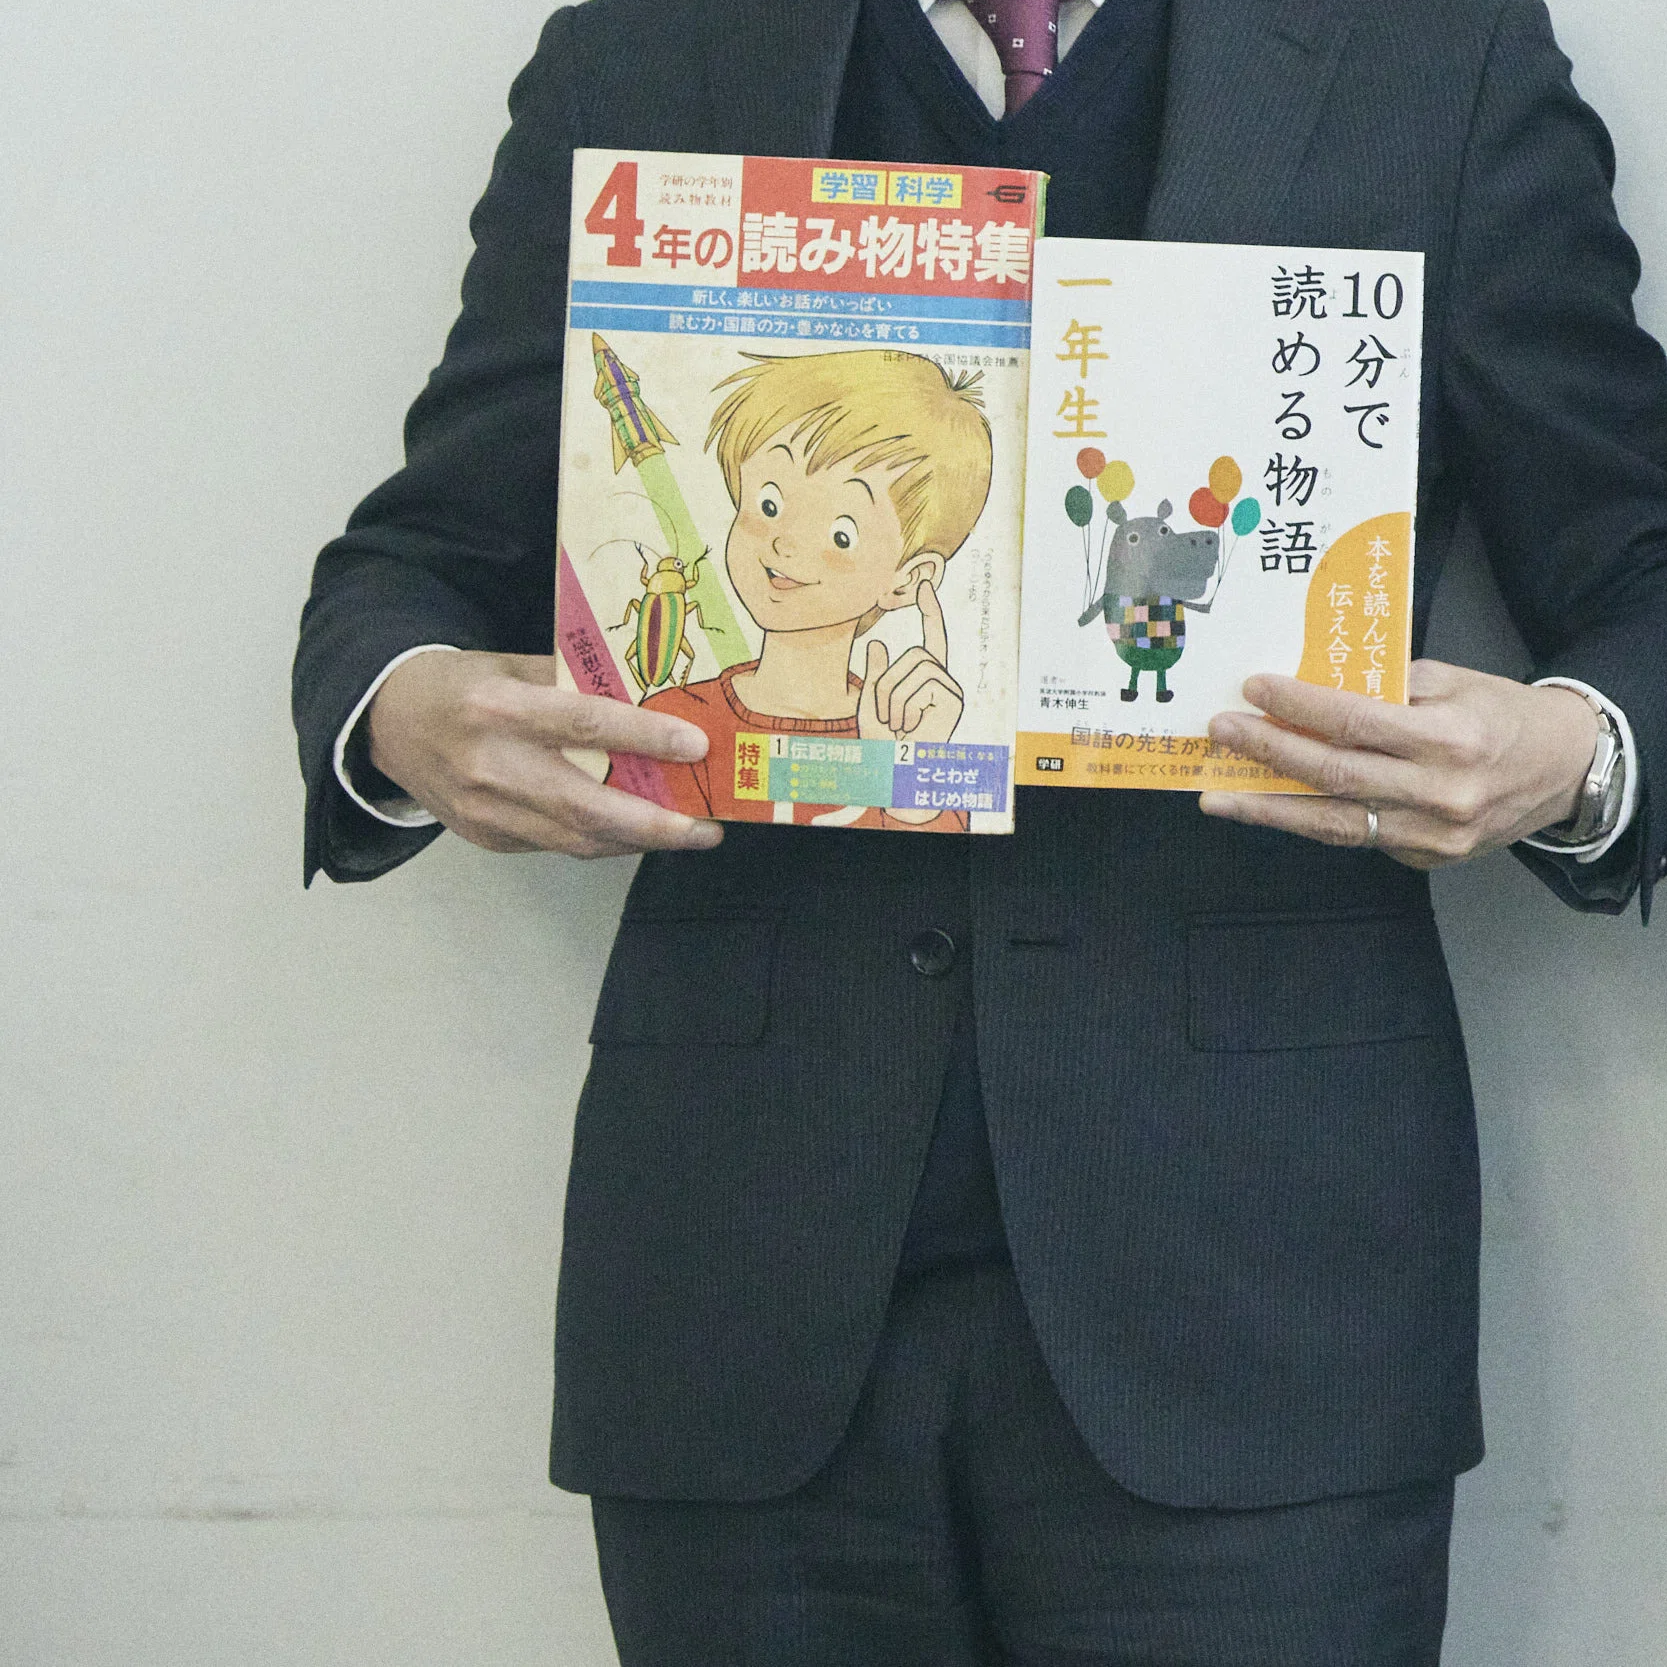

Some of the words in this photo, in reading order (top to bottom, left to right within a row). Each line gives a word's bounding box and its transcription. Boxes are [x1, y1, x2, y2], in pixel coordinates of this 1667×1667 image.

[819, 170, 879, 202] 学習
[895, 174, 954, 204] 科学
[692, 289, 893, 312] 新しく、楽しいお話がいっぱい
[1052, 277, 1113, 439] 一年生
[1343, 271, 1404, 449] 10分で
[1259, 264, 1327, 574] 読める物語
[1361, 535, 1393, 700] 本を読んで育
[1040, 696, 1090, 710] 青木伸生
[790, 742, 863, 764] 伝記物語
[899, 744, 909, 762] 2
[1038, 758, 1062, 770] 学研
[737, 742, 761, 791] 特集
[916, 767, 979, 785] ことわざ
[914, 790, 994, 809] はじめ物語
